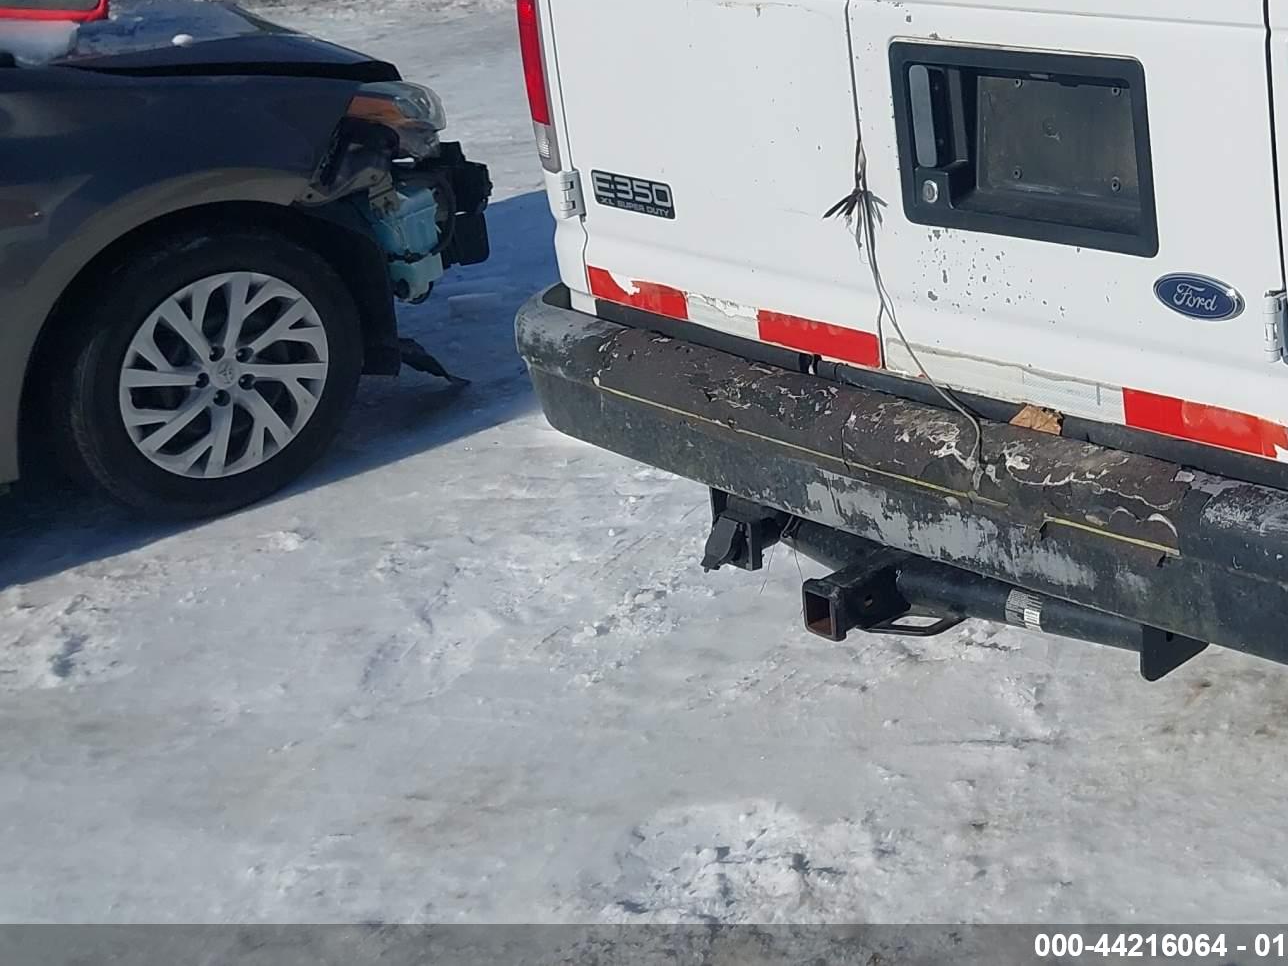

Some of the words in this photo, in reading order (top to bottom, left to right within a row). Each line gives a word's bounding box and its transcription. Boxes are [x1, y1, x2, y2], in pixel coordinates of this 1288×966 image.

[617, 200, 646, 213] SUPER
[646, 206, 670, 217] DUTY
[1172, 282, 1219, 312] Ford
